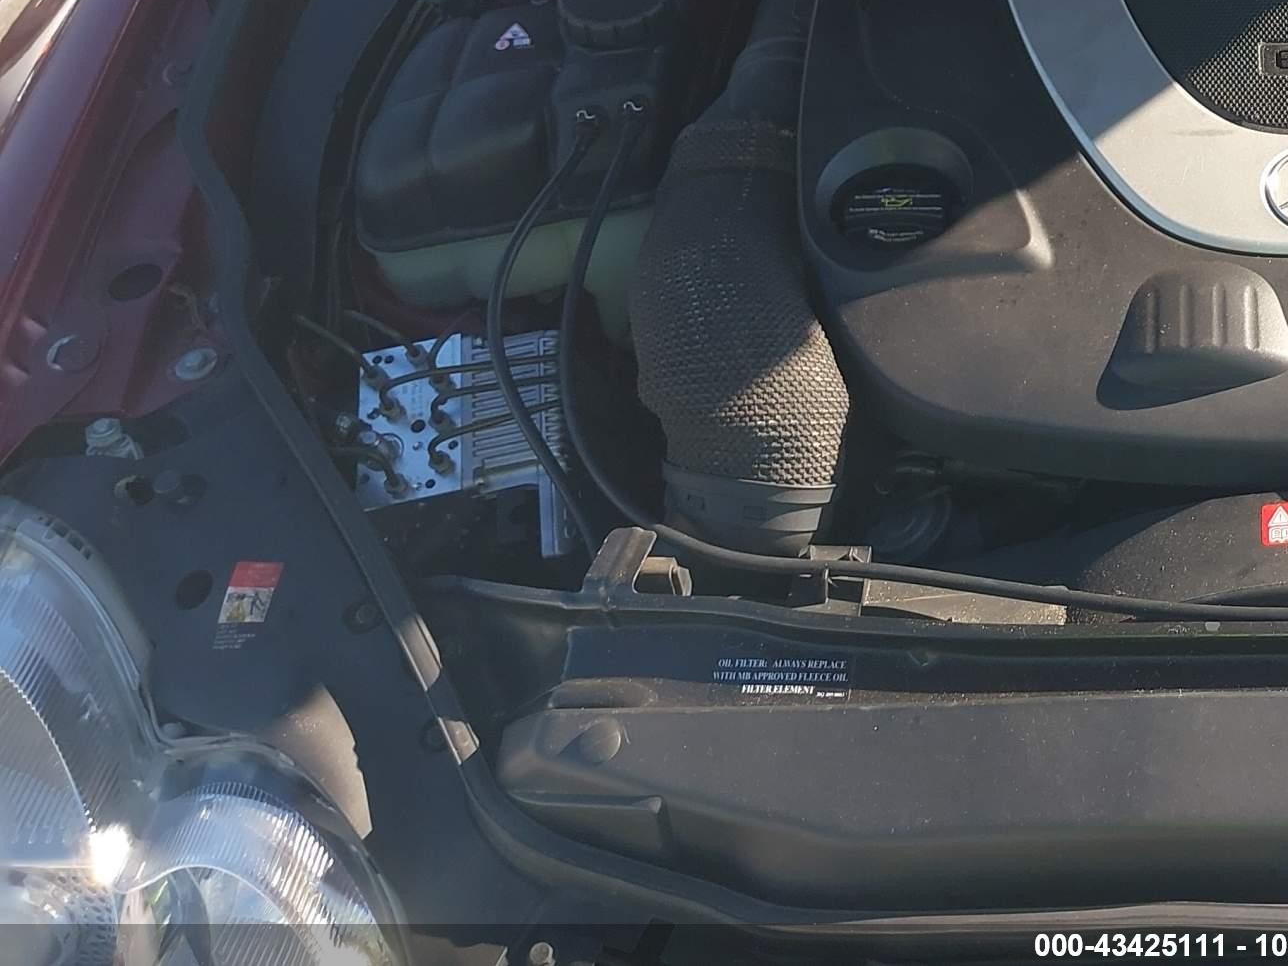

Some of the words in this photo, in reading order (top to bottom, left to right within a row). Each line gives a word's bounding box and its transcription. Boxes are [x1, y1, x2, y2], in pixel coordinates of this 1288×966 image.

[718, 659, 733, 668] OIL
[735, 659, 768, 668] FILTER:
[772, 660, 806, 668] ALWAYS
[808, 660, 847, 669] REPLACE
[713, 672, 736, 680] WITH
[738, 672, 751, 680] MB
[753, 673, 797, 681] APPROVED
[799, 673, 831, 682] FLEECE
[833, 674, 848, 682] OIL
[741, 685, 773, 694] FILTER
[773, 685, 815, 695] ELEMENT
